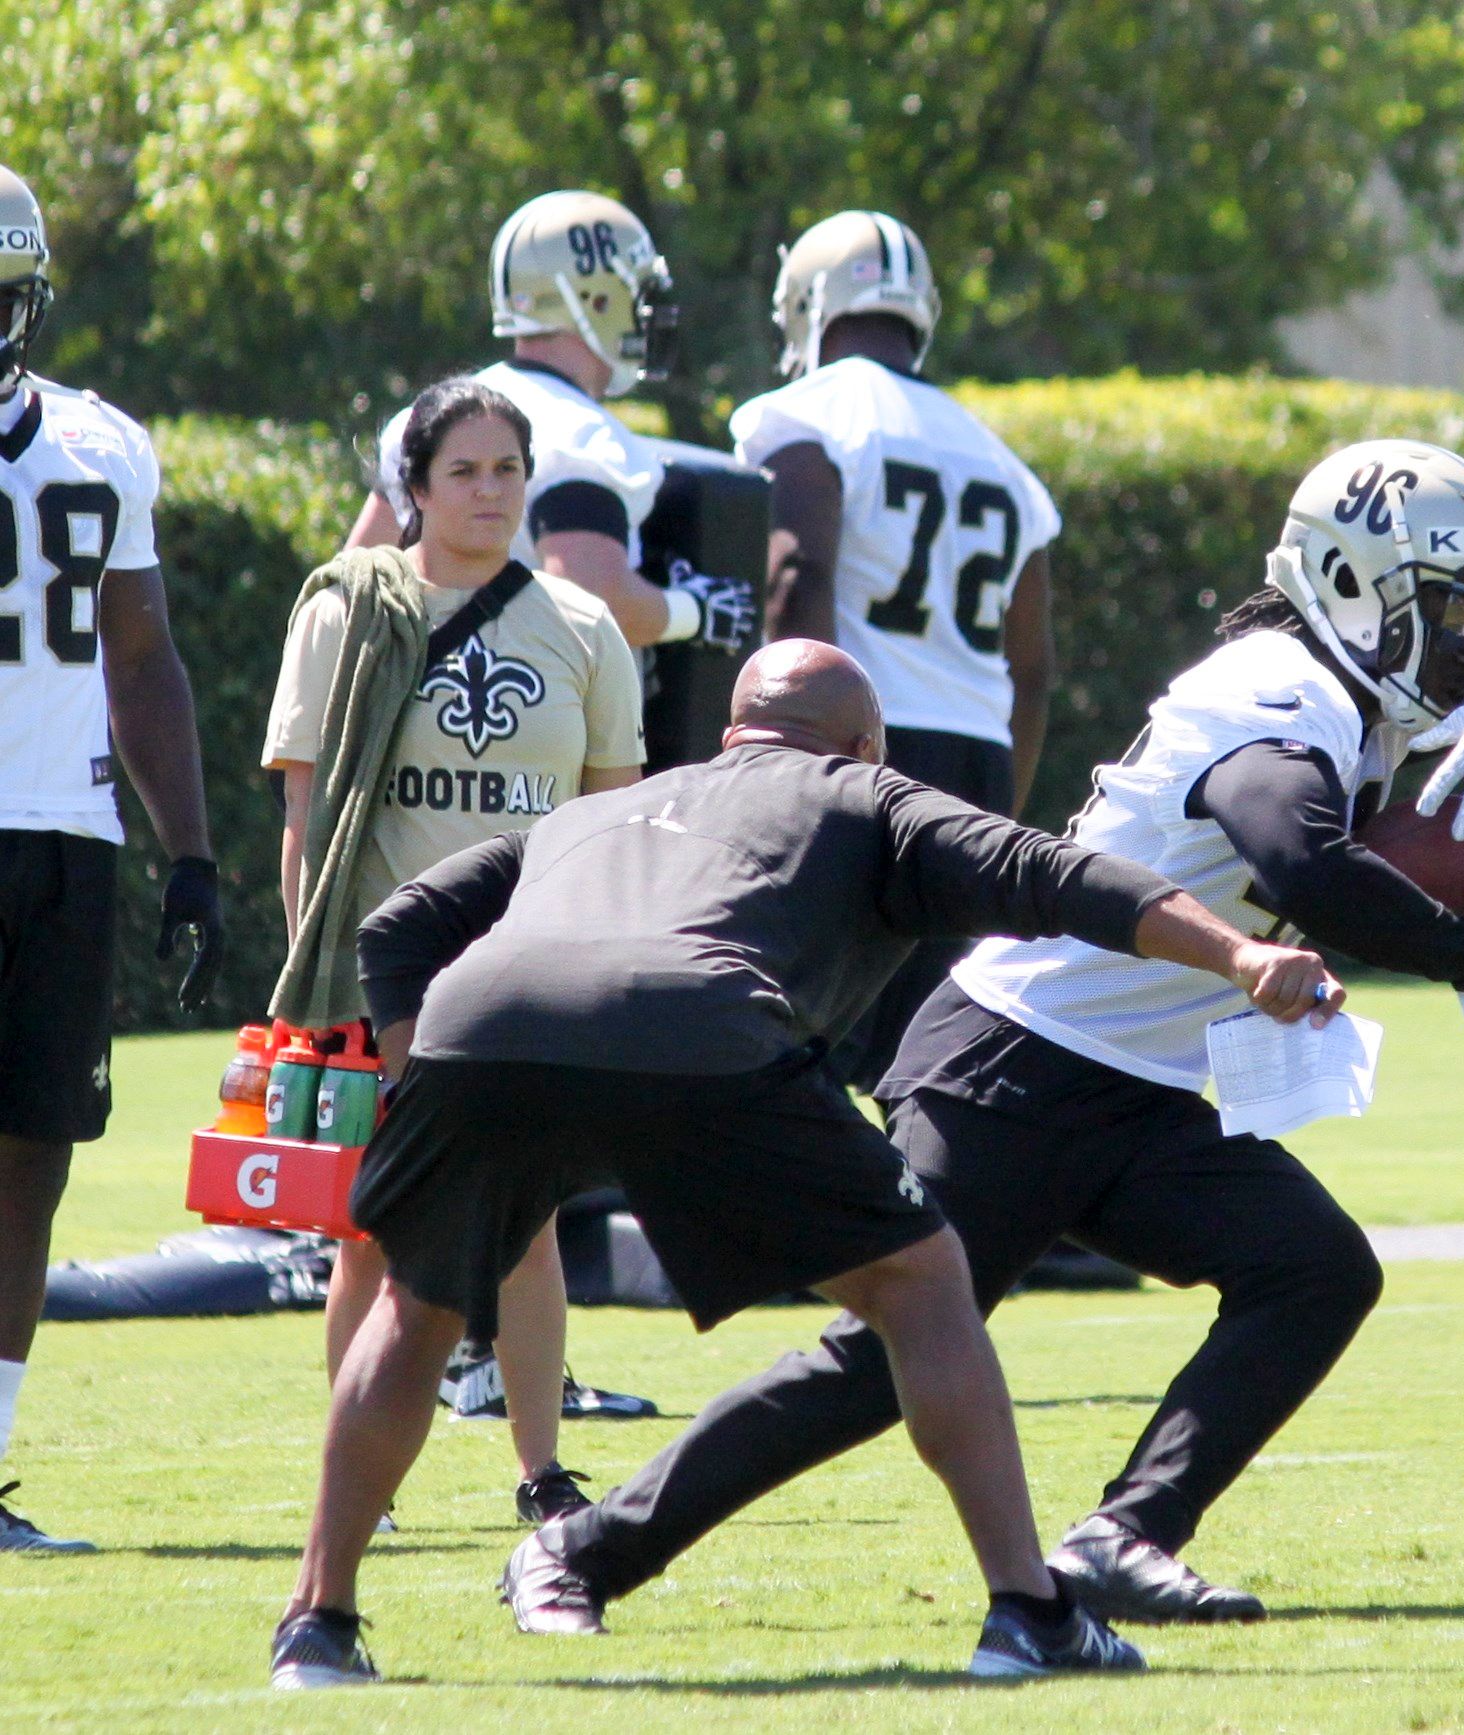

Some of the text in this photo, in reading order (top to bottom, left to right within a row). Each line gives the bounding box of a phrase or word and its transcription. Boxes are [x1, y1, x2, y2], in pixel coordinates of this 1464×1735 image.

[0, 229, 45, 252] ON
[567, 219, 618, 277] 96
[1334, 459, 1419, 535] 96
[0, 482, 120, 668] 8
[867, 456, 1021, 656] 72
[385, 764, 557, 817] OOTBALL
[236, 1152, 282, 1209] G
